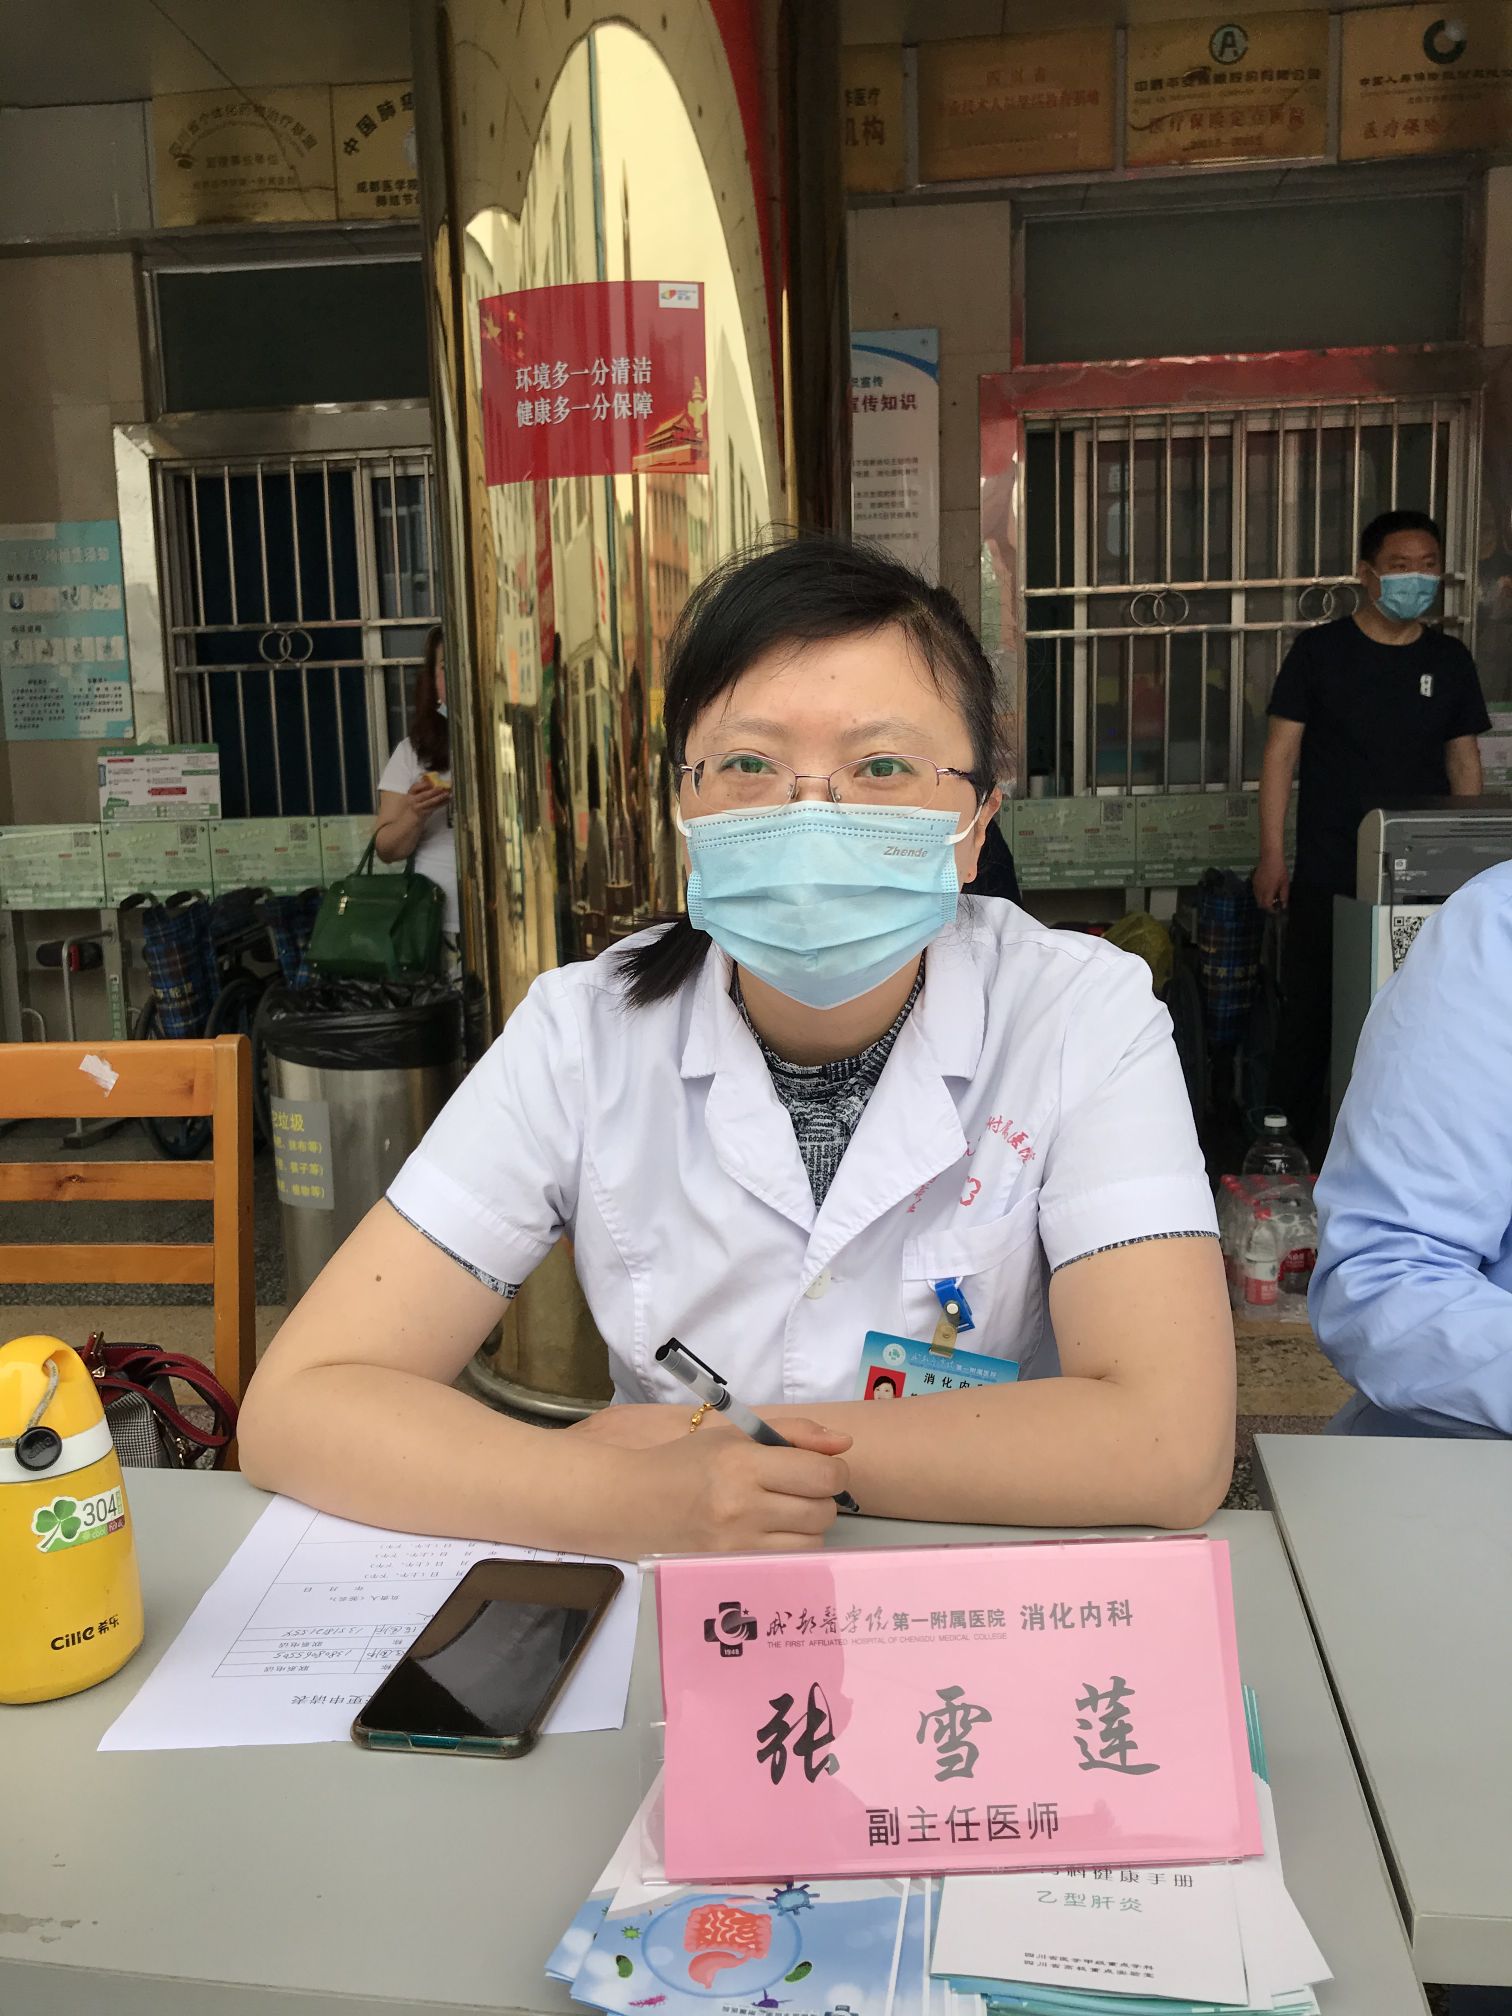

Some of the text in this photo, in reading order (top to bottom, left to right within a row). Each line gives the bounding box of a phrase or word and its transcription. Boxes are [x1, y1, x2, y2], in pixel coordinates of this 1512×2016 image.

[515, 356, 653, 393] 环境多一分清洁
[515, 392, 654, 429] 健康多一分保障
[883, 845, 928, 858] Zhende
[923, 1372, 984, 1391] 消化内
[82, 1494, 118, 1527] 304
[98, 1613, 120, 1635] 希乐
[1019, 1599, 1133, 1632] 消化内科
[767, 1632, 1008, 1649] THE FIRST AFFILIATED HOSPITAL OF CHENGDU MEDICAL COLLEGE
[291, 1694, 373, 1706] 更申请表
[756, 1676, 1161, 1786] 张雪莲
[864, 1800, 1060, 1847] 副主任医师
[1040, 1867, 1193, 1888] 科健康手册
[1036, 1889, 1143, 1913] 乙型肝炎
